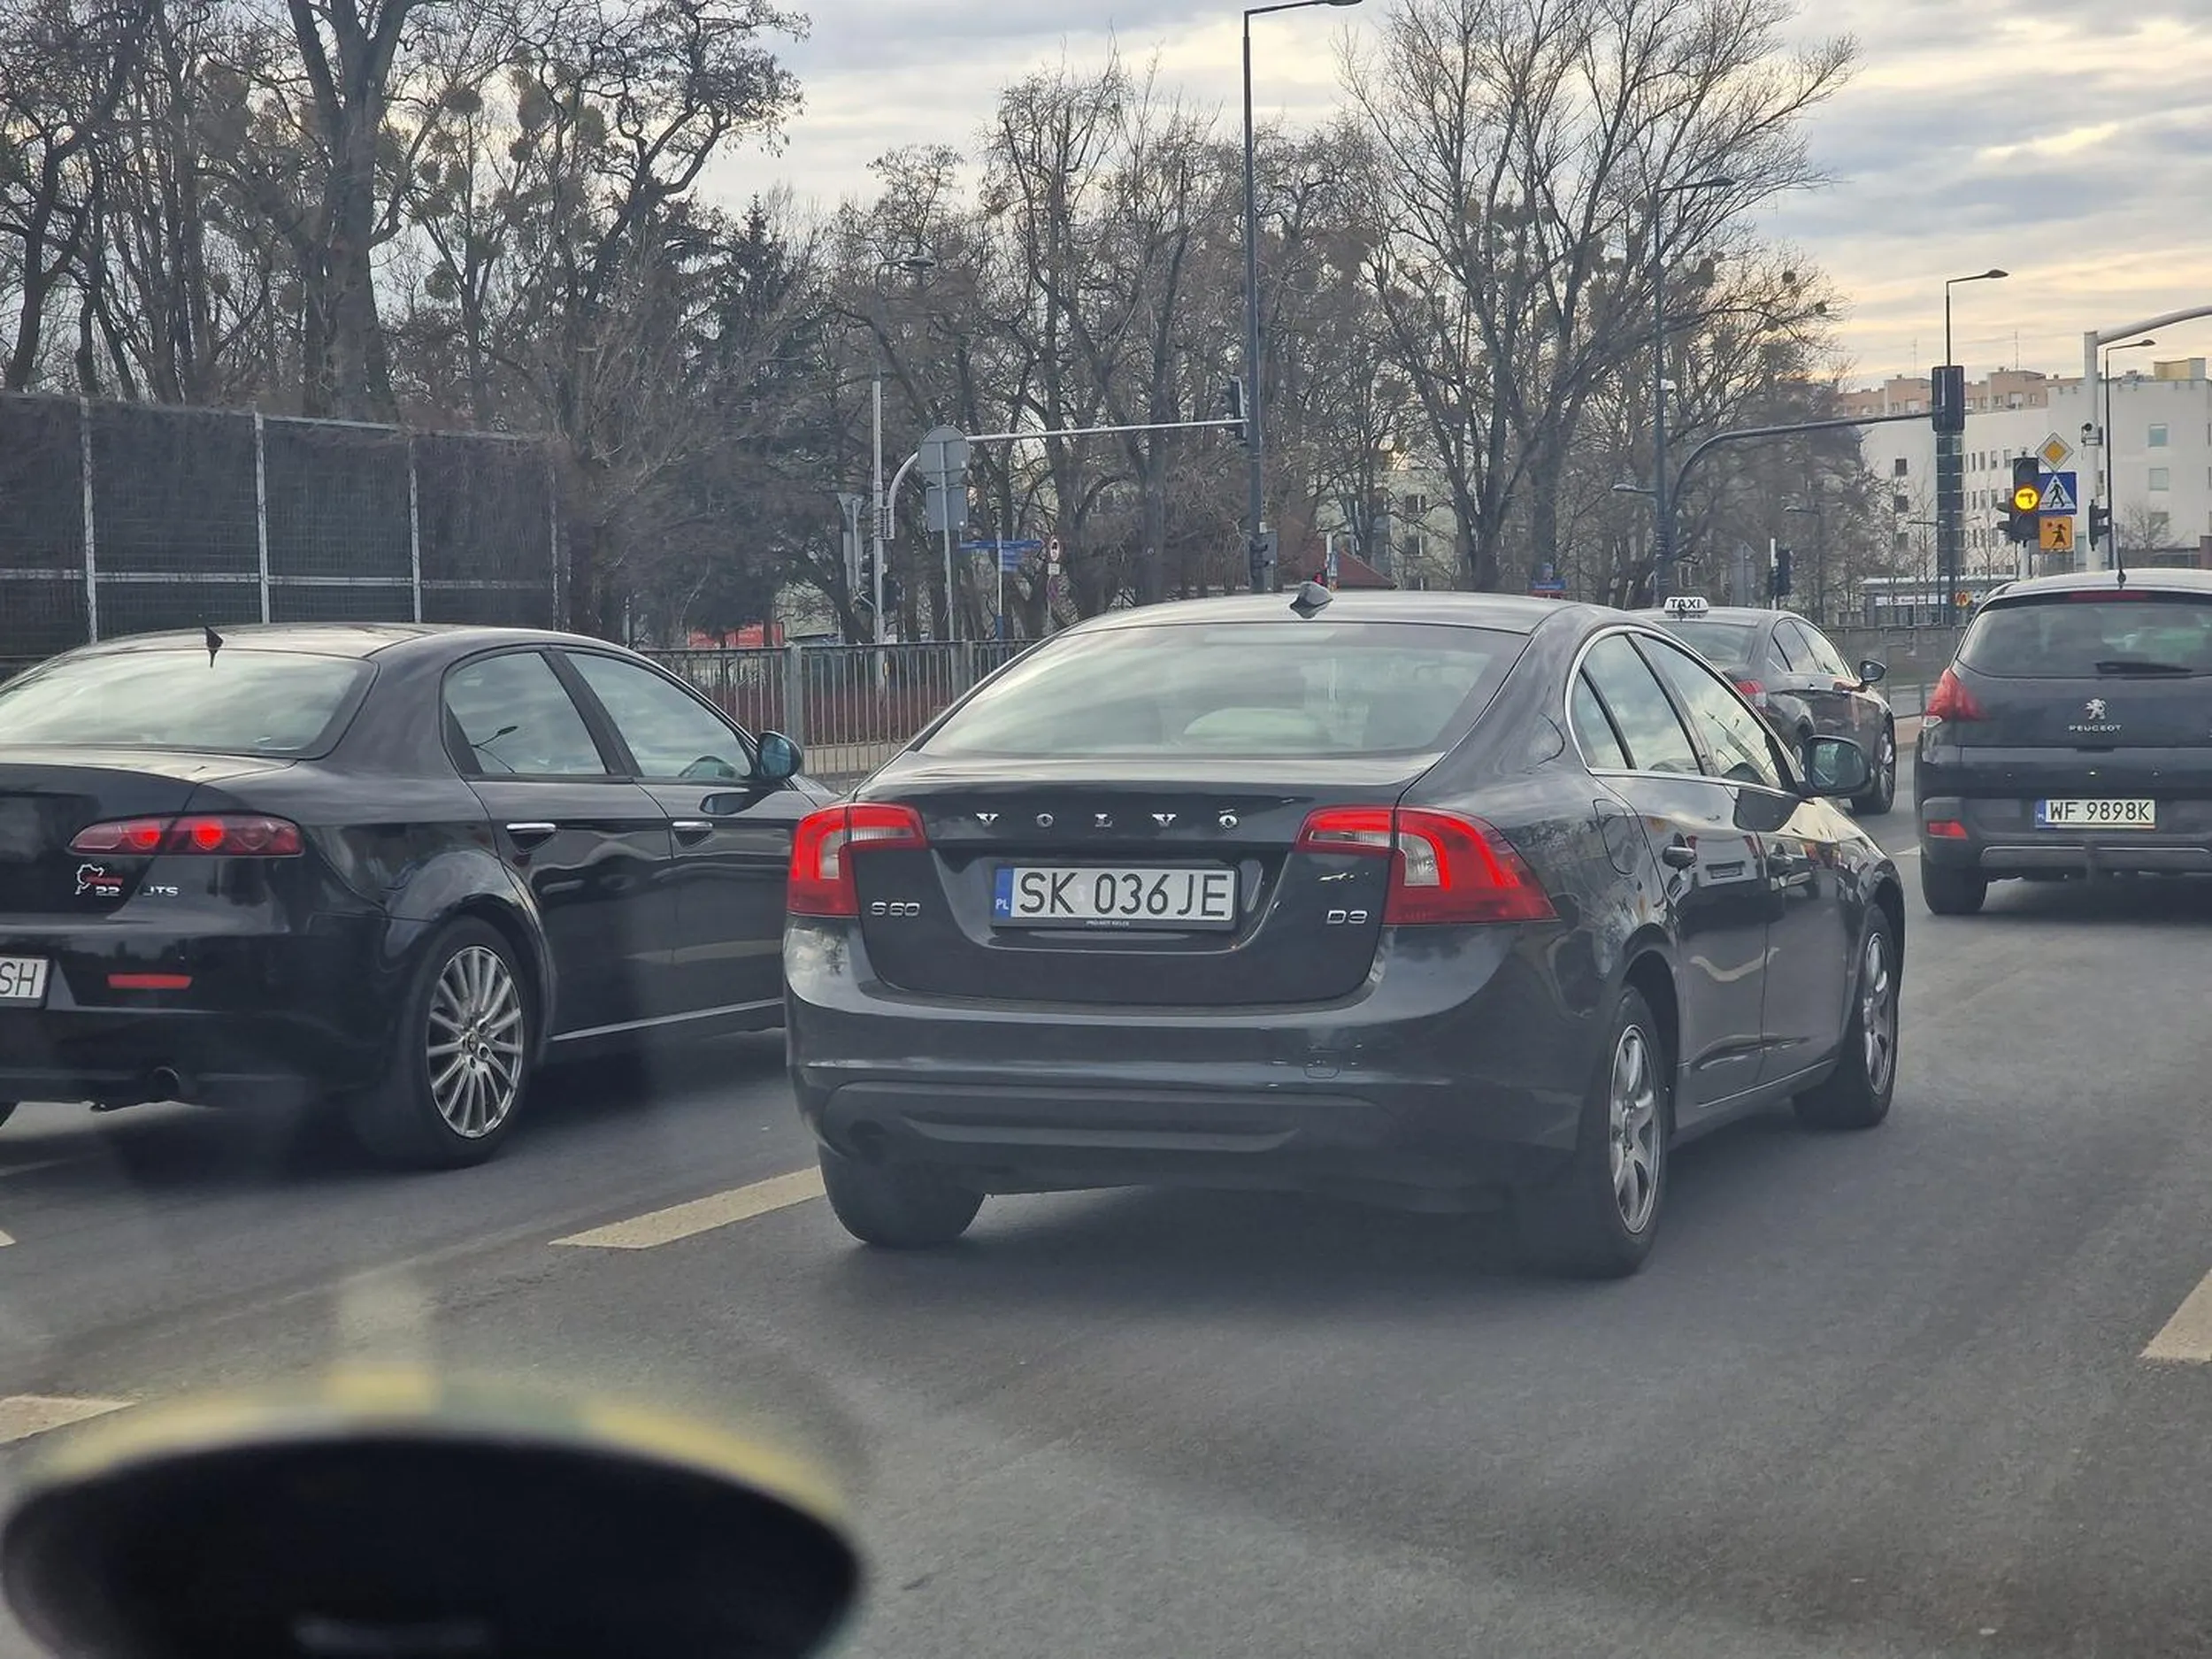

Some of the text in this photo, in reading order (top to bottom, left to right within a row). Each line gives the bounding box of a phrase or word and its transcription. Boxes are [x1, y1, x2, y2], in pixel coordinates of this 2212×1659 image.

[1669, 598, 1701, 609] TAXI
[2069, 724, 2123, 733] PEUGEOT
[2049, 801, 2079, 821] WF
[2086, 801, 2151, 821] 9898K
[976, 811, 1239, 831] VOLVO
[142, 886, 180, 896] JTS
[1019, 872, 1228, 917] SK 036JE
[871, 901, 920, 917] S60
[995, 898, 1010, 910] PL
[1326, 910, 1369, 925] D3
